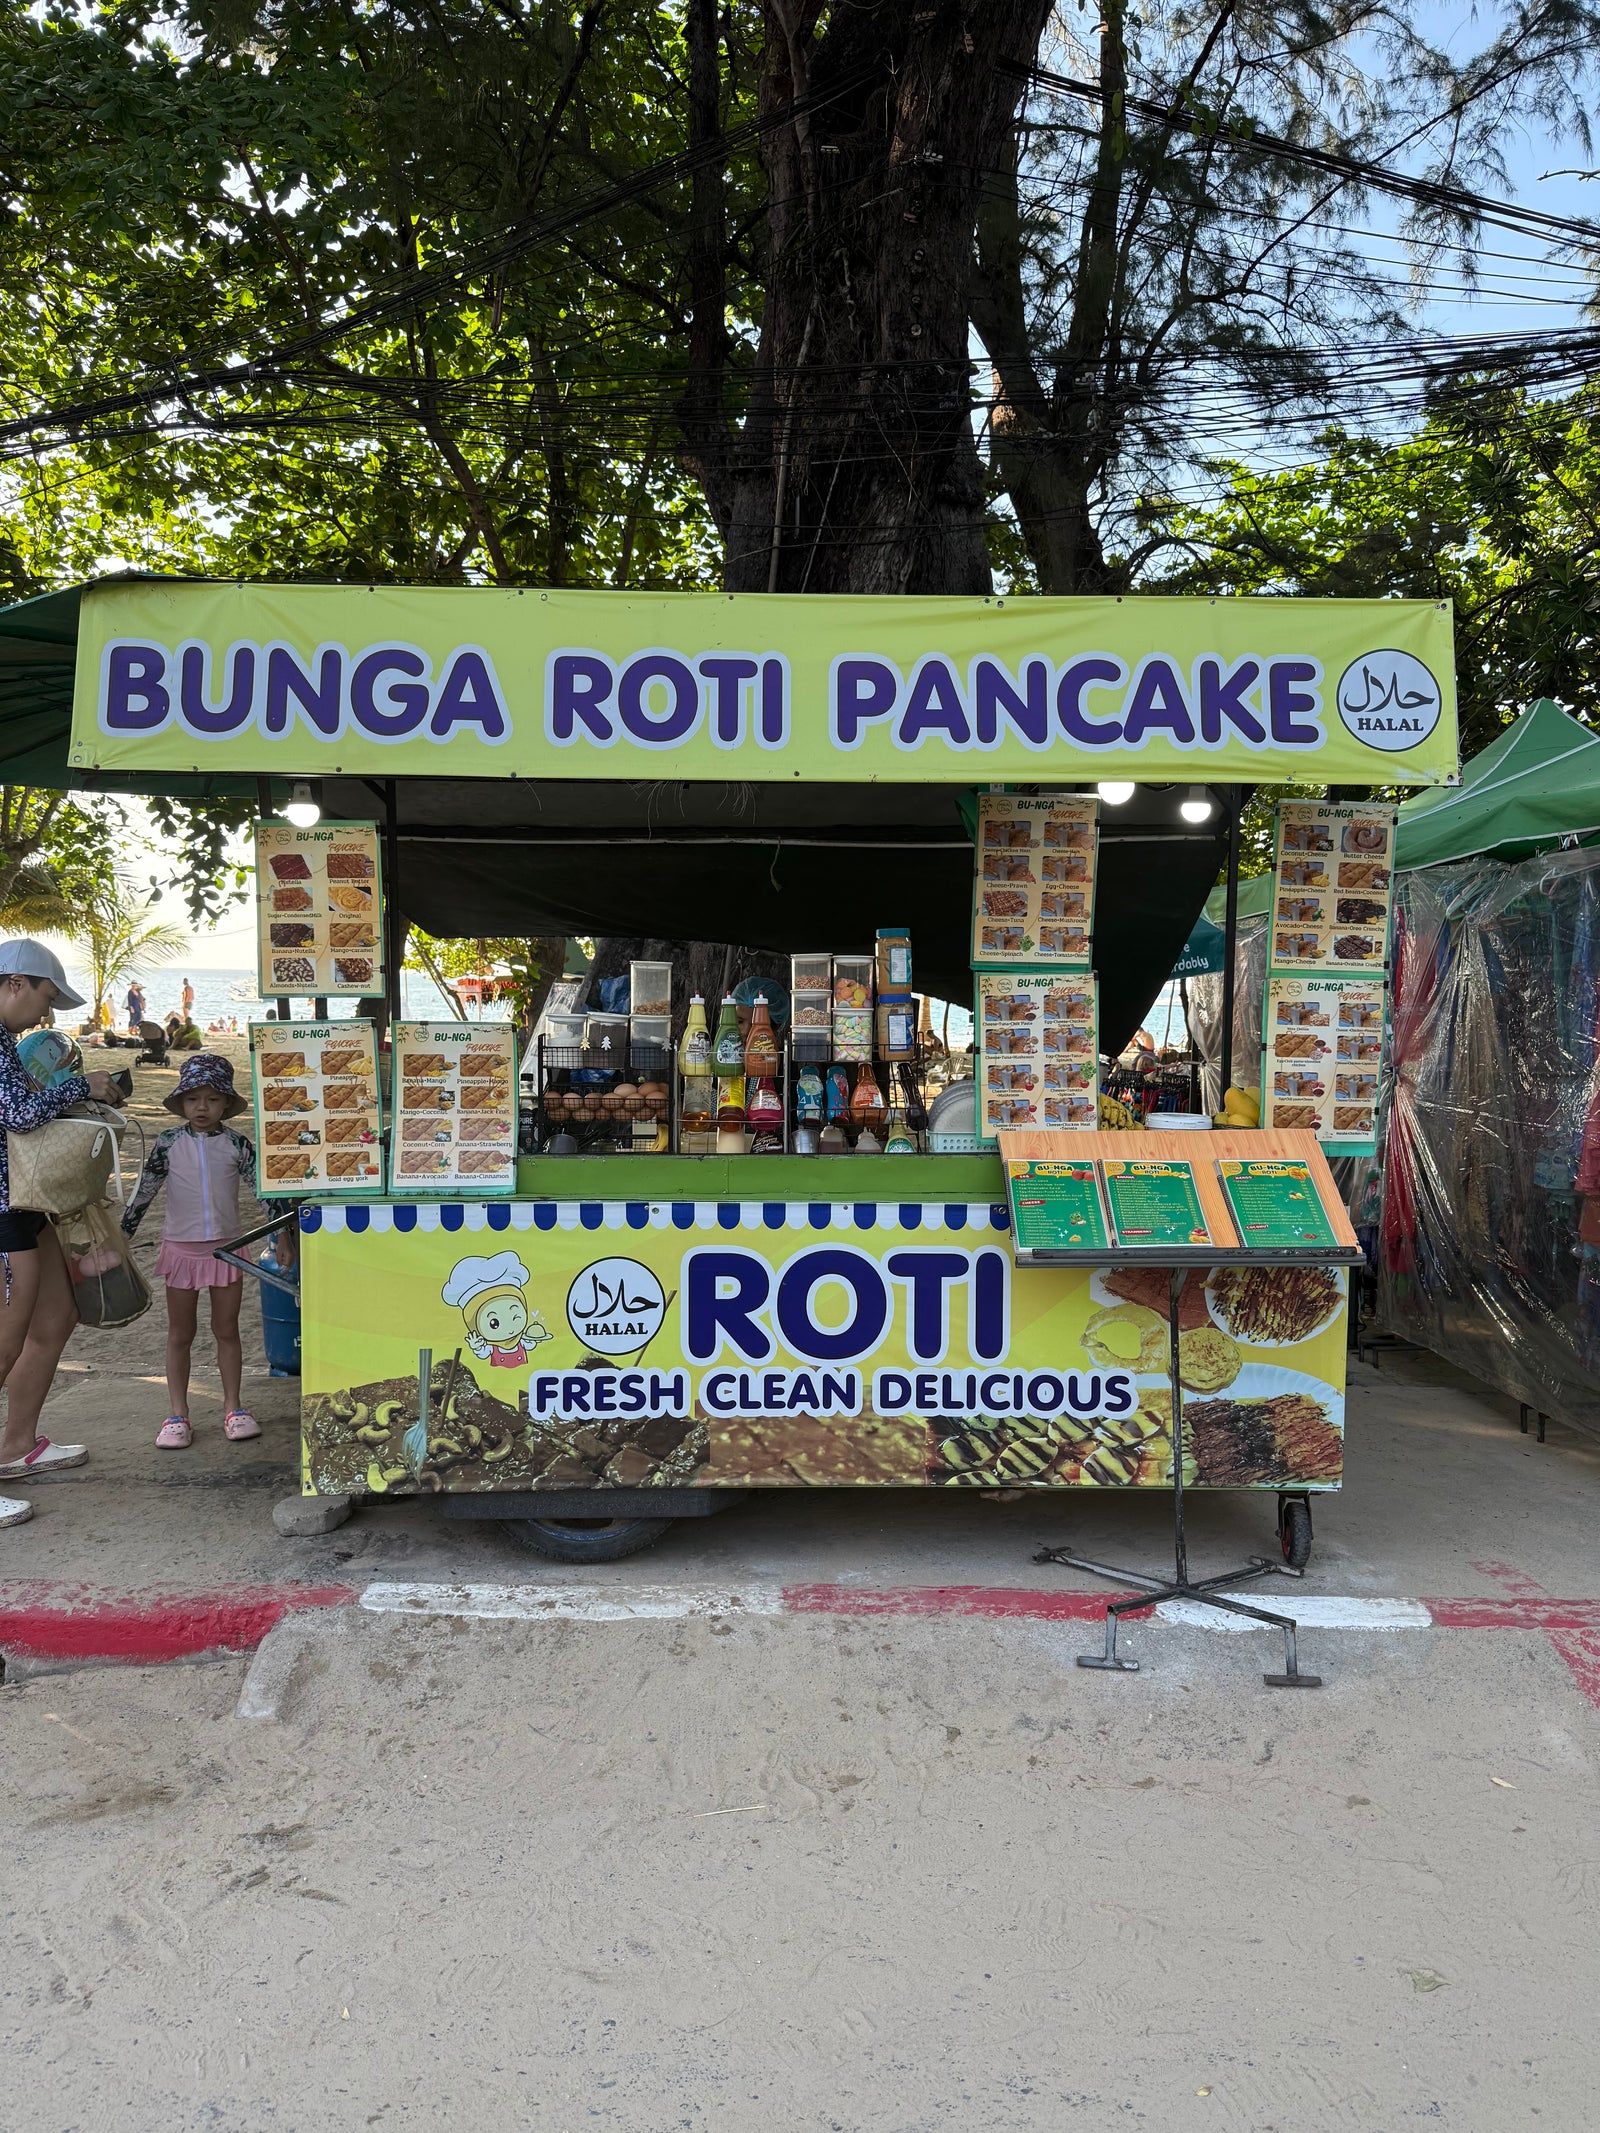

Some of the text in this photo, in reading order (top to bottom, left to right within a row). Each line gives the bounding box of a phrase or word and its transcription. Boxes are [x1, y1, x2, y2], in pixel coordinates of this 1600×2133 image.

[1343, 664, 1436, 712] حلال
[104, 644, 1320, 745] BUNGA ROTI PANCAKE
[1357, 717, 1424, 731] HALAL
[1017, 800, 1055, 810] BU-NGA
[1317, 808, 1354, 818] BU-NGA
[296, 831, 334, 841] BU-NGA
[1017, 978, 1054, 988] BU-NGA
[1307, 982, 1344, 992] BU-NGA
[292, 1029, 331, 1039] BU-NGA
[434, 1032, 472, 1042] BU-NGA
[572, 1272, 661, 1319] حلال
[687, 1249, 1004, 1360] ROTI
[584, 1322, 649, 1336] HALAL
[536, 1373, 1132, 1412] FRESH CLEAN DELICIOUS
